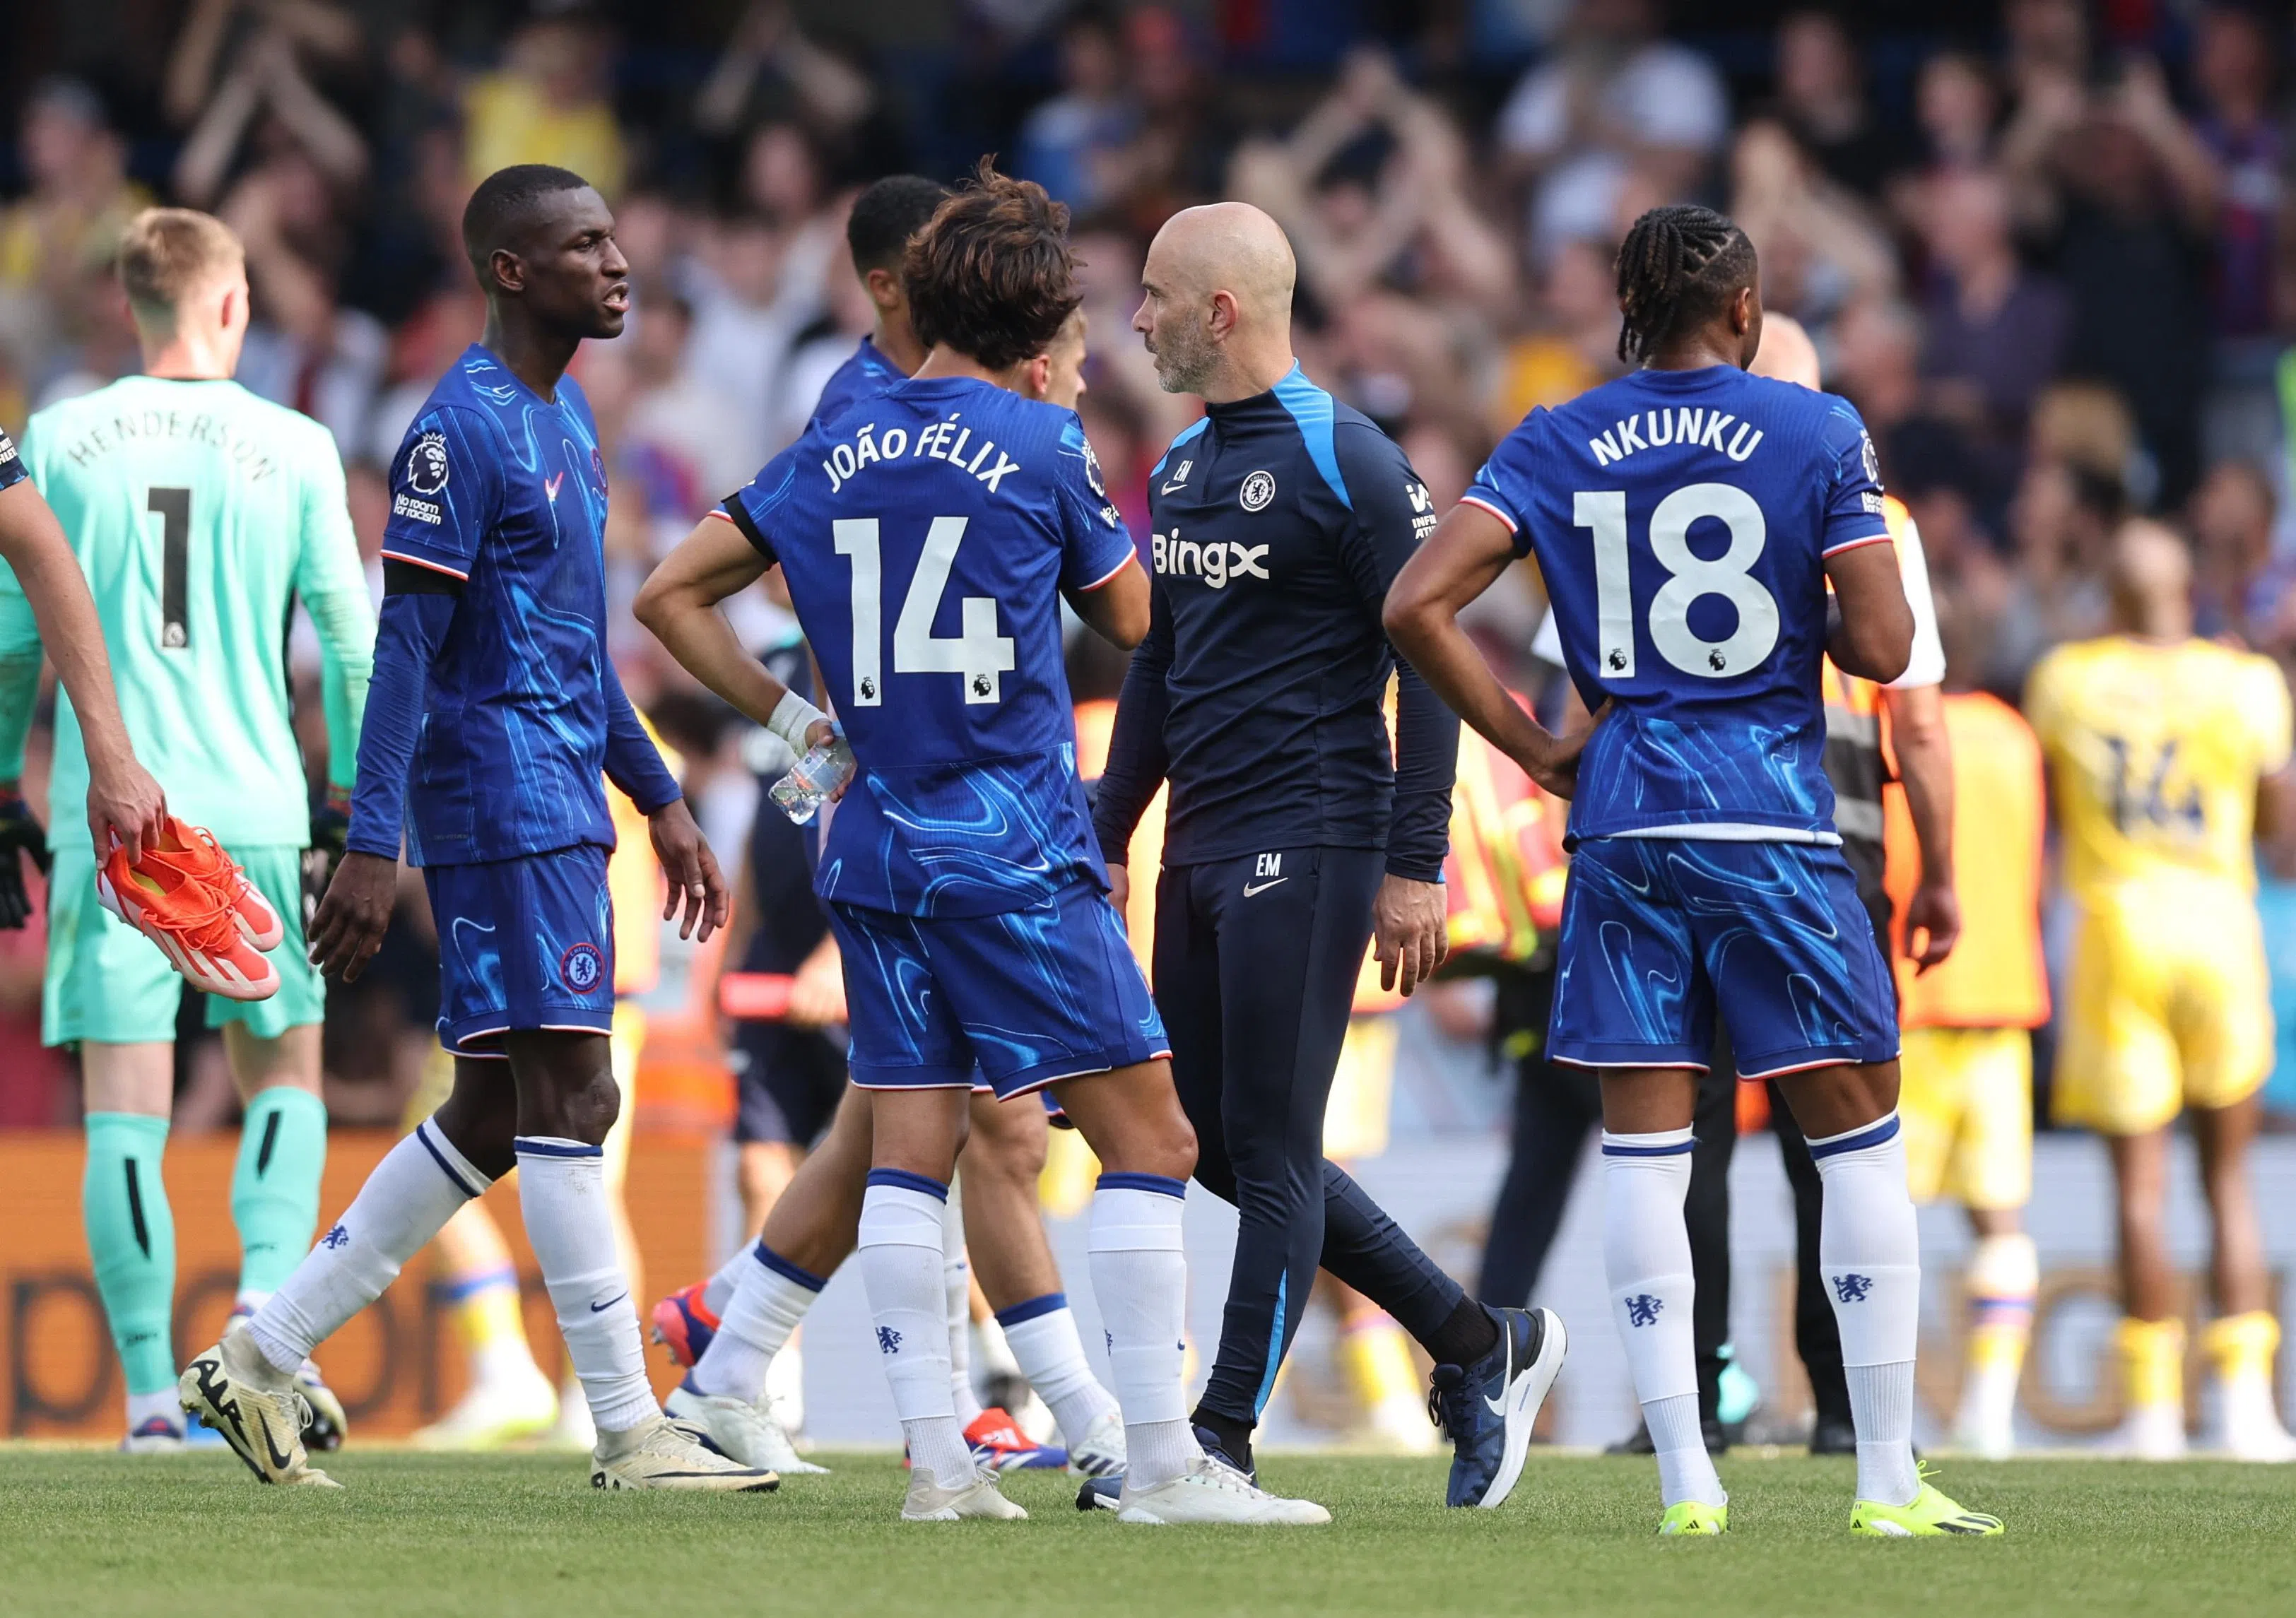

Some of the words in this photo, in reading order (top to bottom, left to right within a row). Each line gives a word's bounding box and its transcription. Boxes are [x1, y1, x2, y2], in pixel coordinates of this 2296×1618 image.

[68, 411, 277, 481] HENDERSON
[822, 423, 907, 493] JOÃO
[913, 413, 1020, 493] FÉLIX
[1589, 407, 1764, 466] NKUNKU
[1173, 460, 1194, 482] EM
[1250, 474, 1270, 483] CHELSEA
[393, 502, 408, 516] for
[406, 508, 442, 525] racism
[396, 493, 410, 507] No
[409, 499, 439, 514] room
[147, 488, 192, 648] 1
[1573, 482, 1780, 678] 18
[832, 516, 1015, 707] 14
[1255, 853, 1282, 877] EM
[570, 947, 596, 957] CHELSEA
